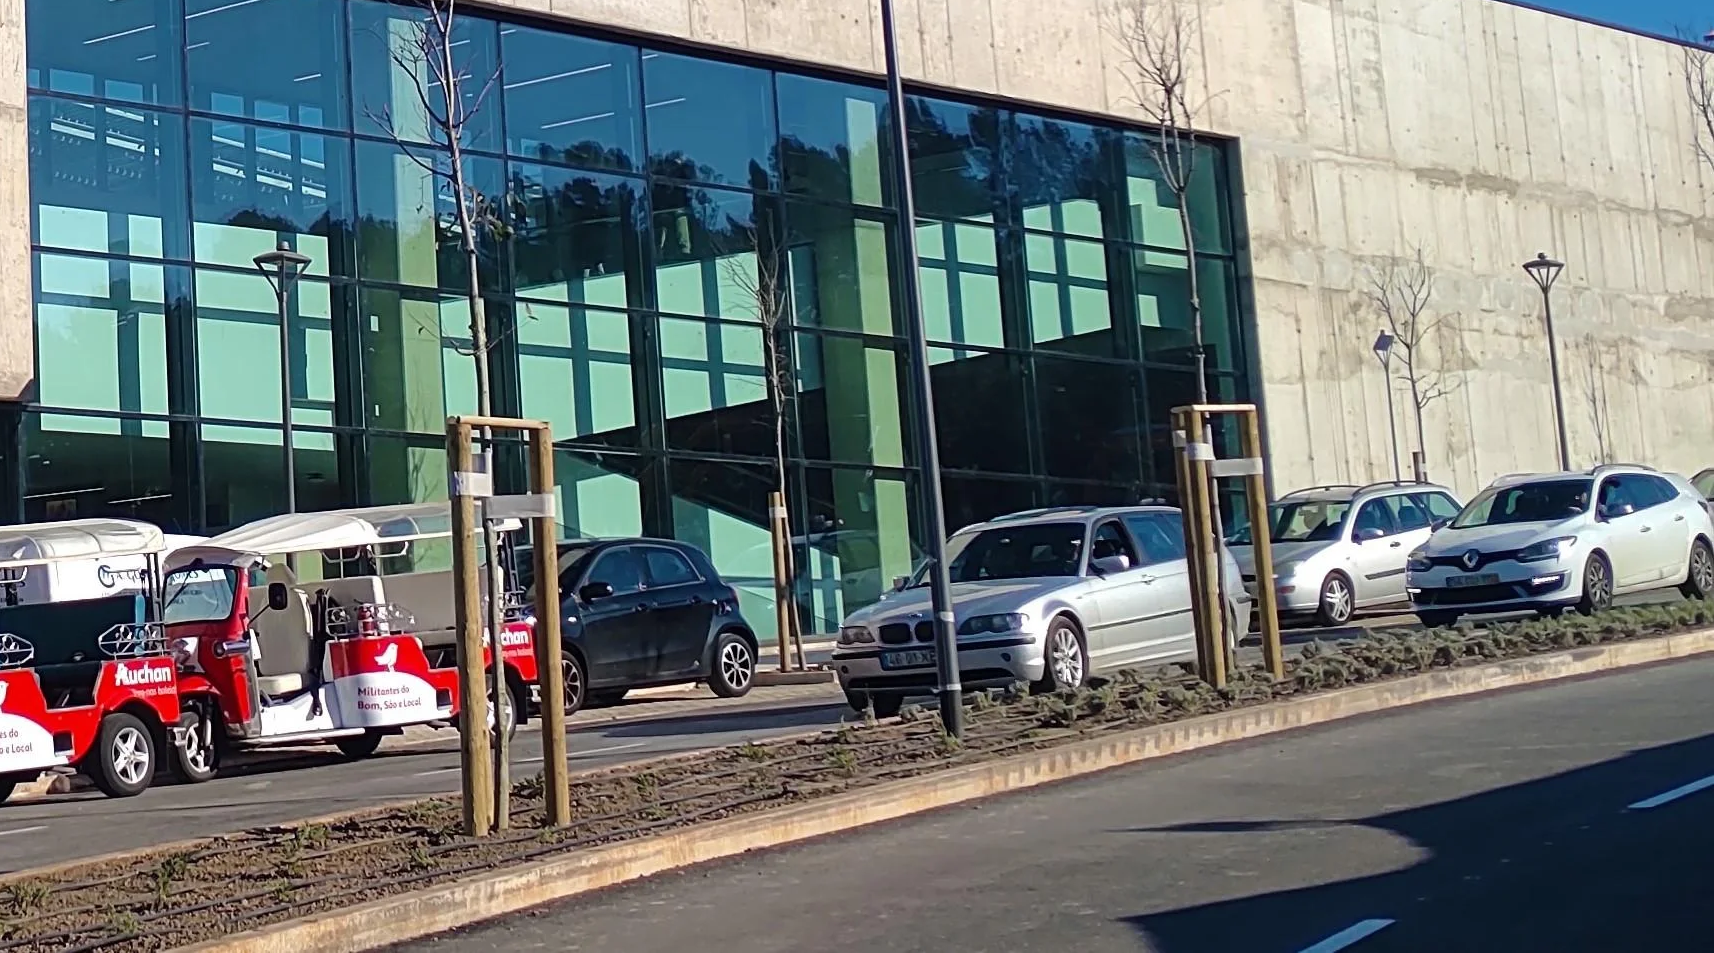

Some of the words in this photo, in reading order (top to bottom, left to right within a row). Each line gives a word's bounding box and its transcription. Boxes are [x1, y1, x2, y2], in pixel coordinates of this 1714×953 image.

[115, 661, 172, 686] Auchan
[358, 686, 399, 696] Militantes
[401, 685, 409, 693] do
[358, 700, 382, 710] Bom,
[403, 697, 421, 707] Local
[8, 728, 18, 738] do
[12, 742, 32, 754] Local
